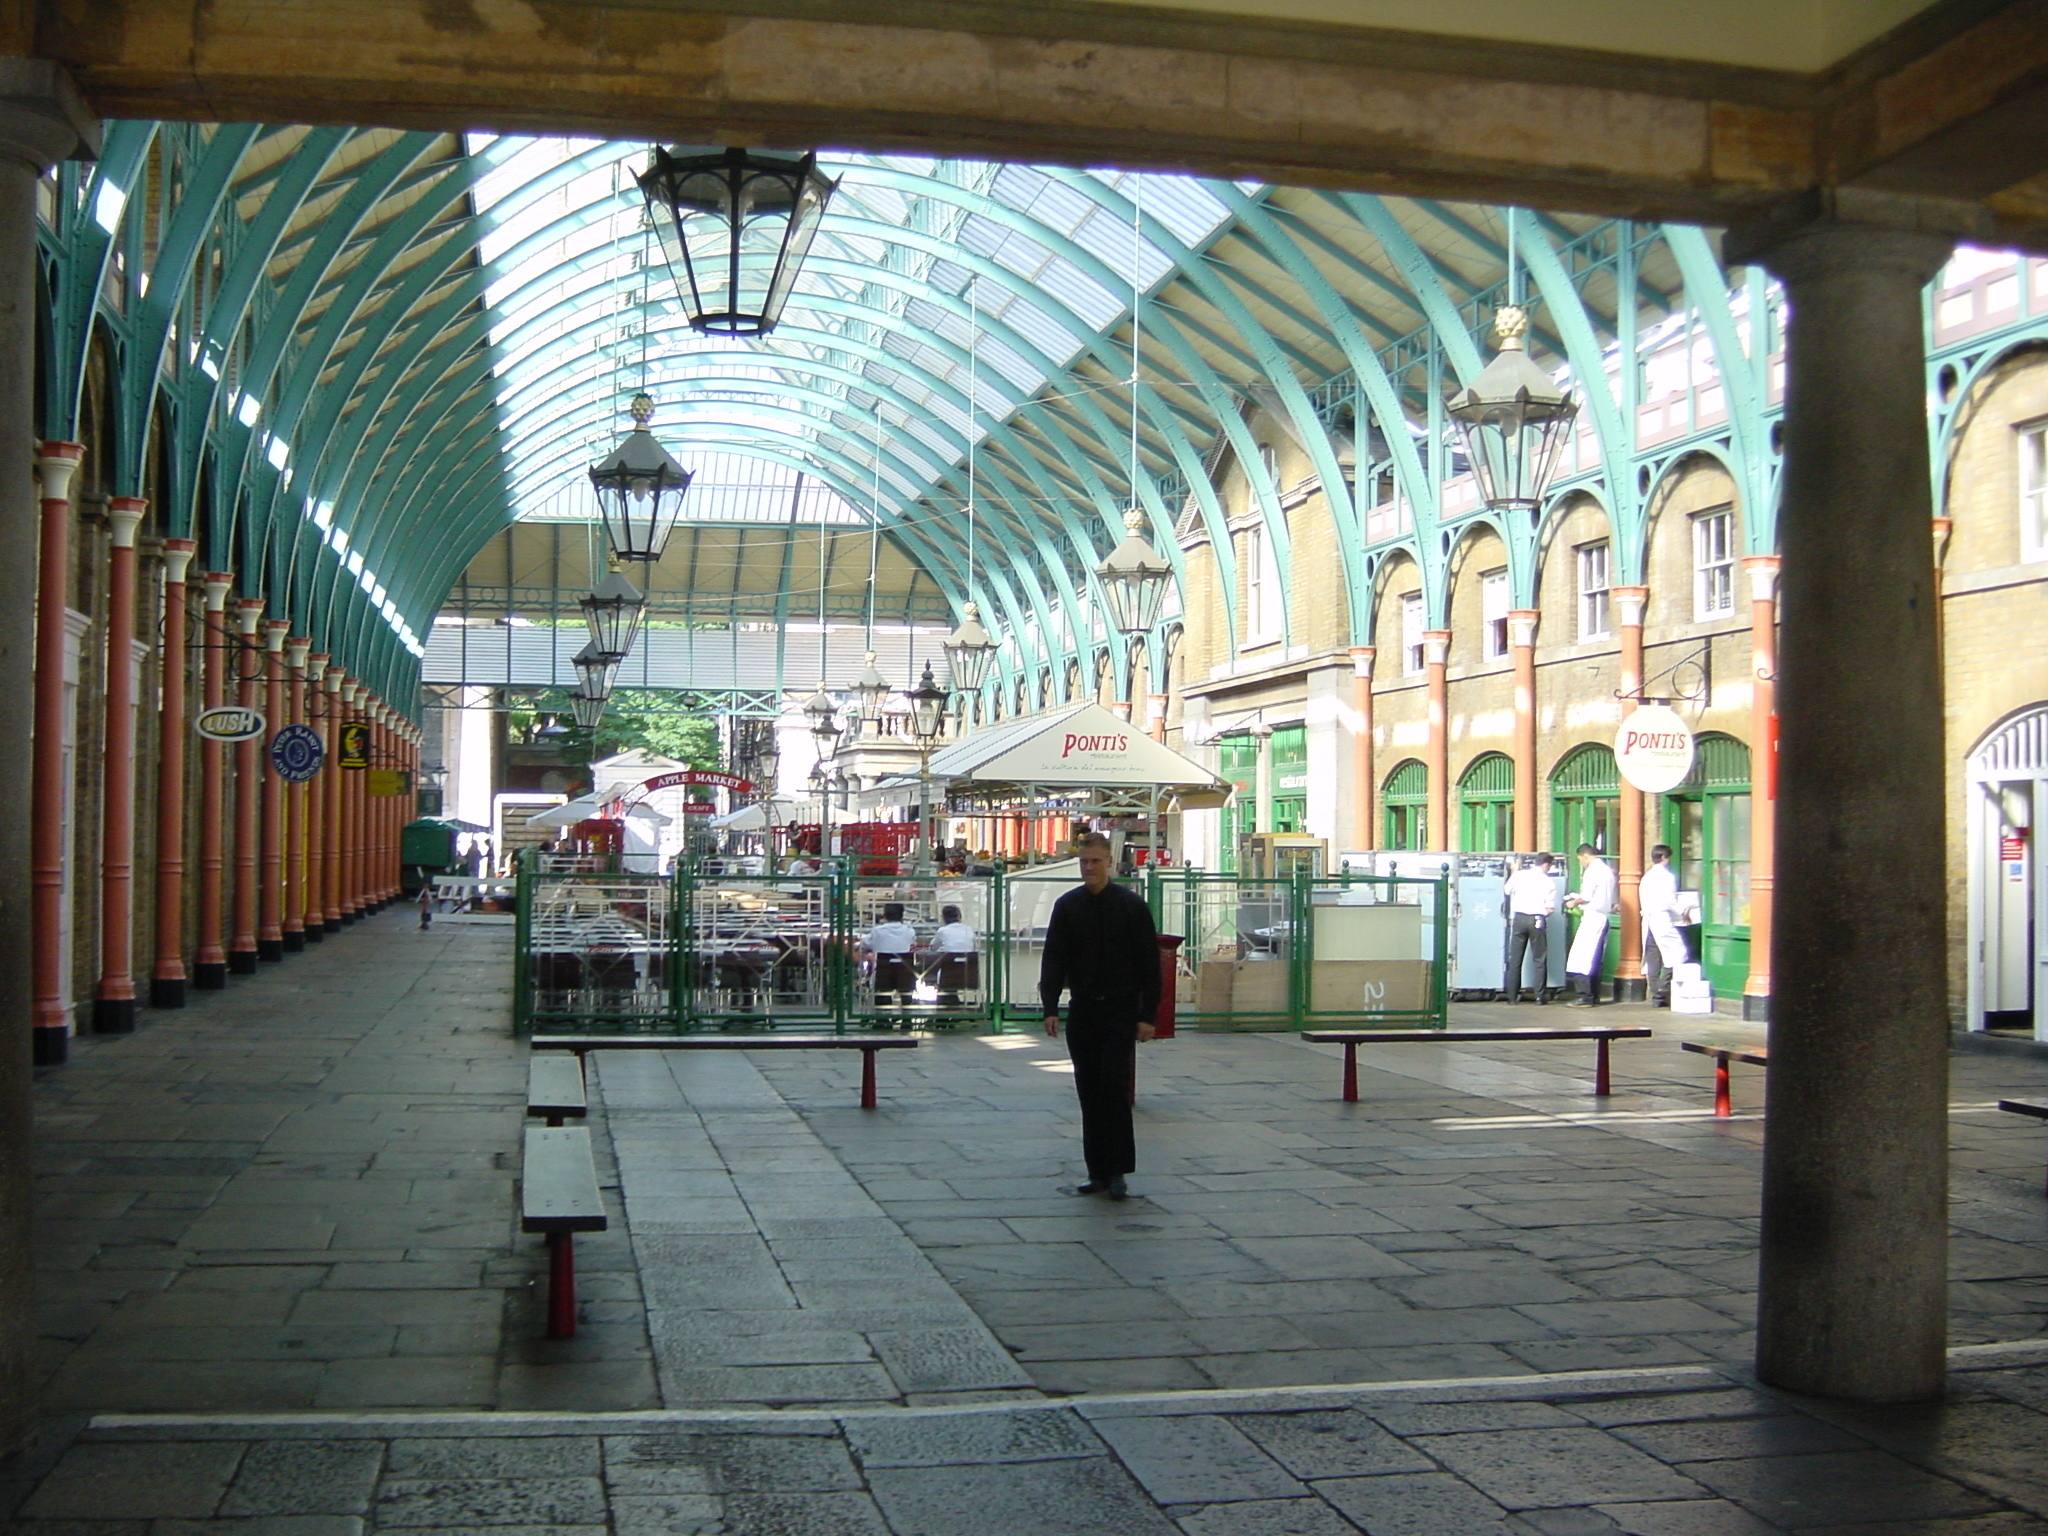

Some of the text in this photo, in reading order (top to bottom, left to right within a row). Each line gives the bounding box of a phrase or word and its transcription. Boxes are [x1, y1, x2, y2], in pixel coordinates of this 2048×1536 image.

[206, 712, 254, 732] LUSH
[1062, 733, 1128, 758] PONTI'S
[1624, 731, 1686, 755] PONTI'S
[657, 773, 742, 788] APPLE MARKET
